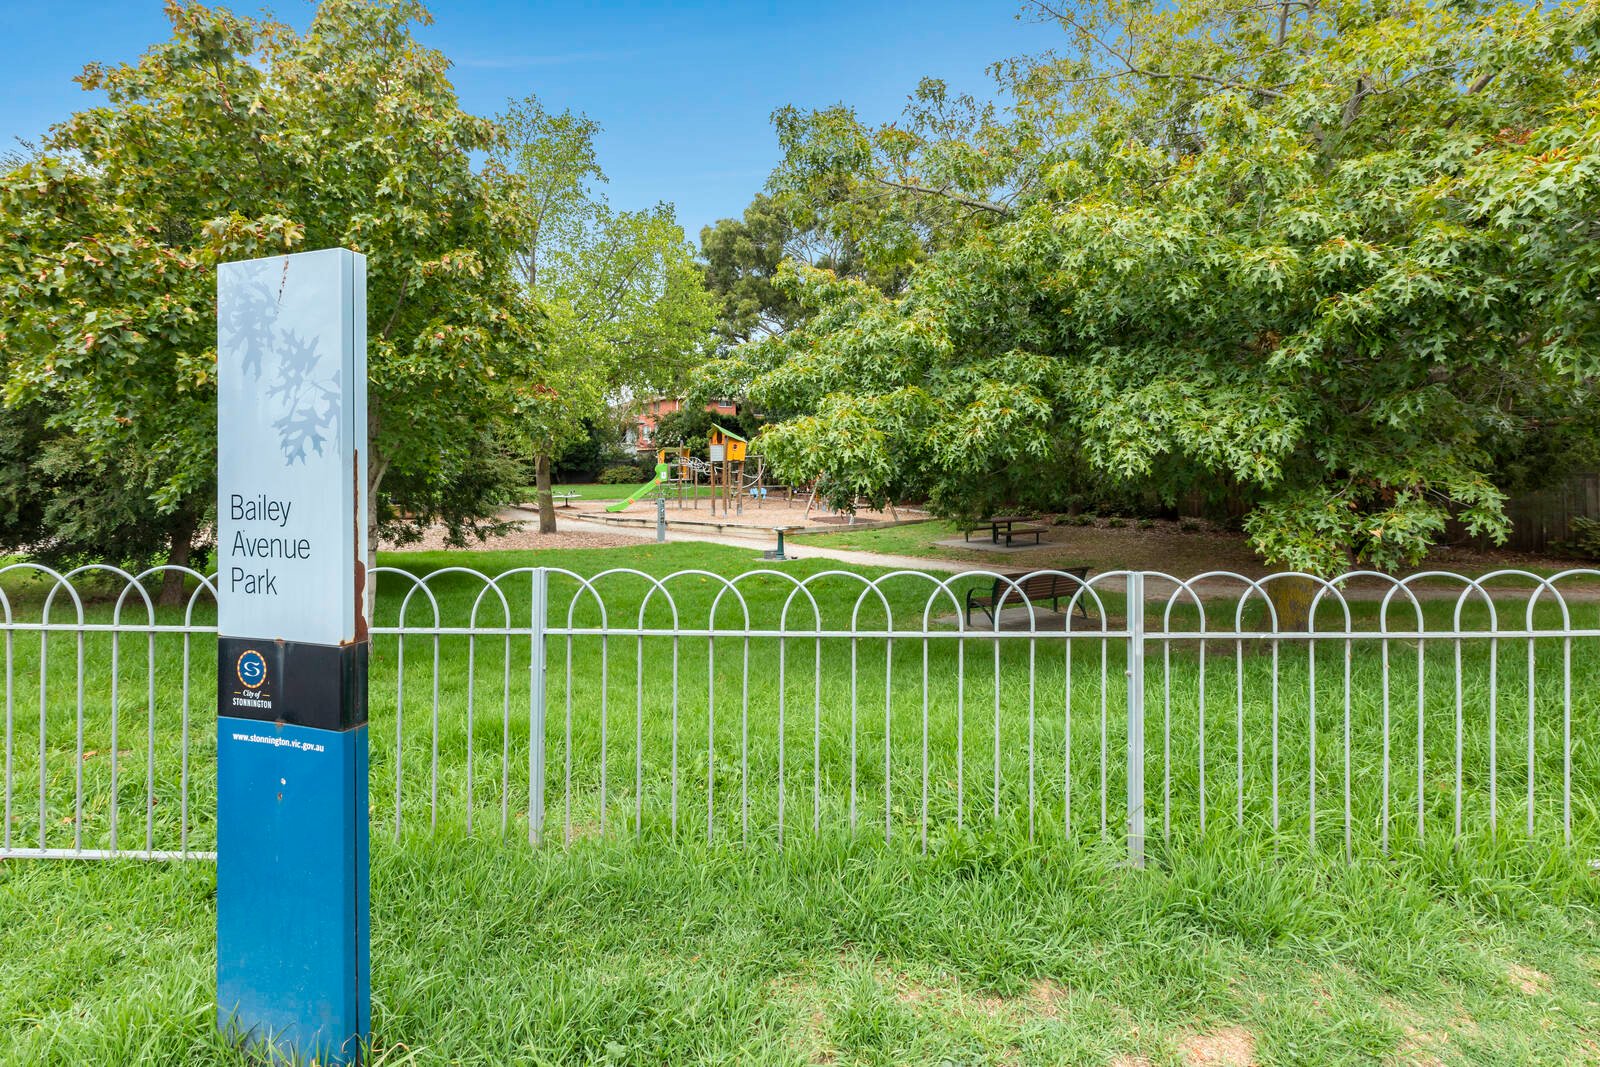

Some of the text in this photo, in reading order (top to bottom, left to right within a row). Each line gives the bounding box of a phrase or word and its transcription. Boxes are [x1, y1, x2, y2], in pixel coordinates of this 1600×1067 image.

[231, 494, 291, 527] Bailey
[232, 530, 310, 559] Avenue
[231, 567, 278, 595] Park
[244, 661, 260, 677] S
[232, 697, 272, 709] STONNINGTON
[242, 689, 262, 699] City of
[232, 733, 325, 752] www.stonnington.vic.gov.au
